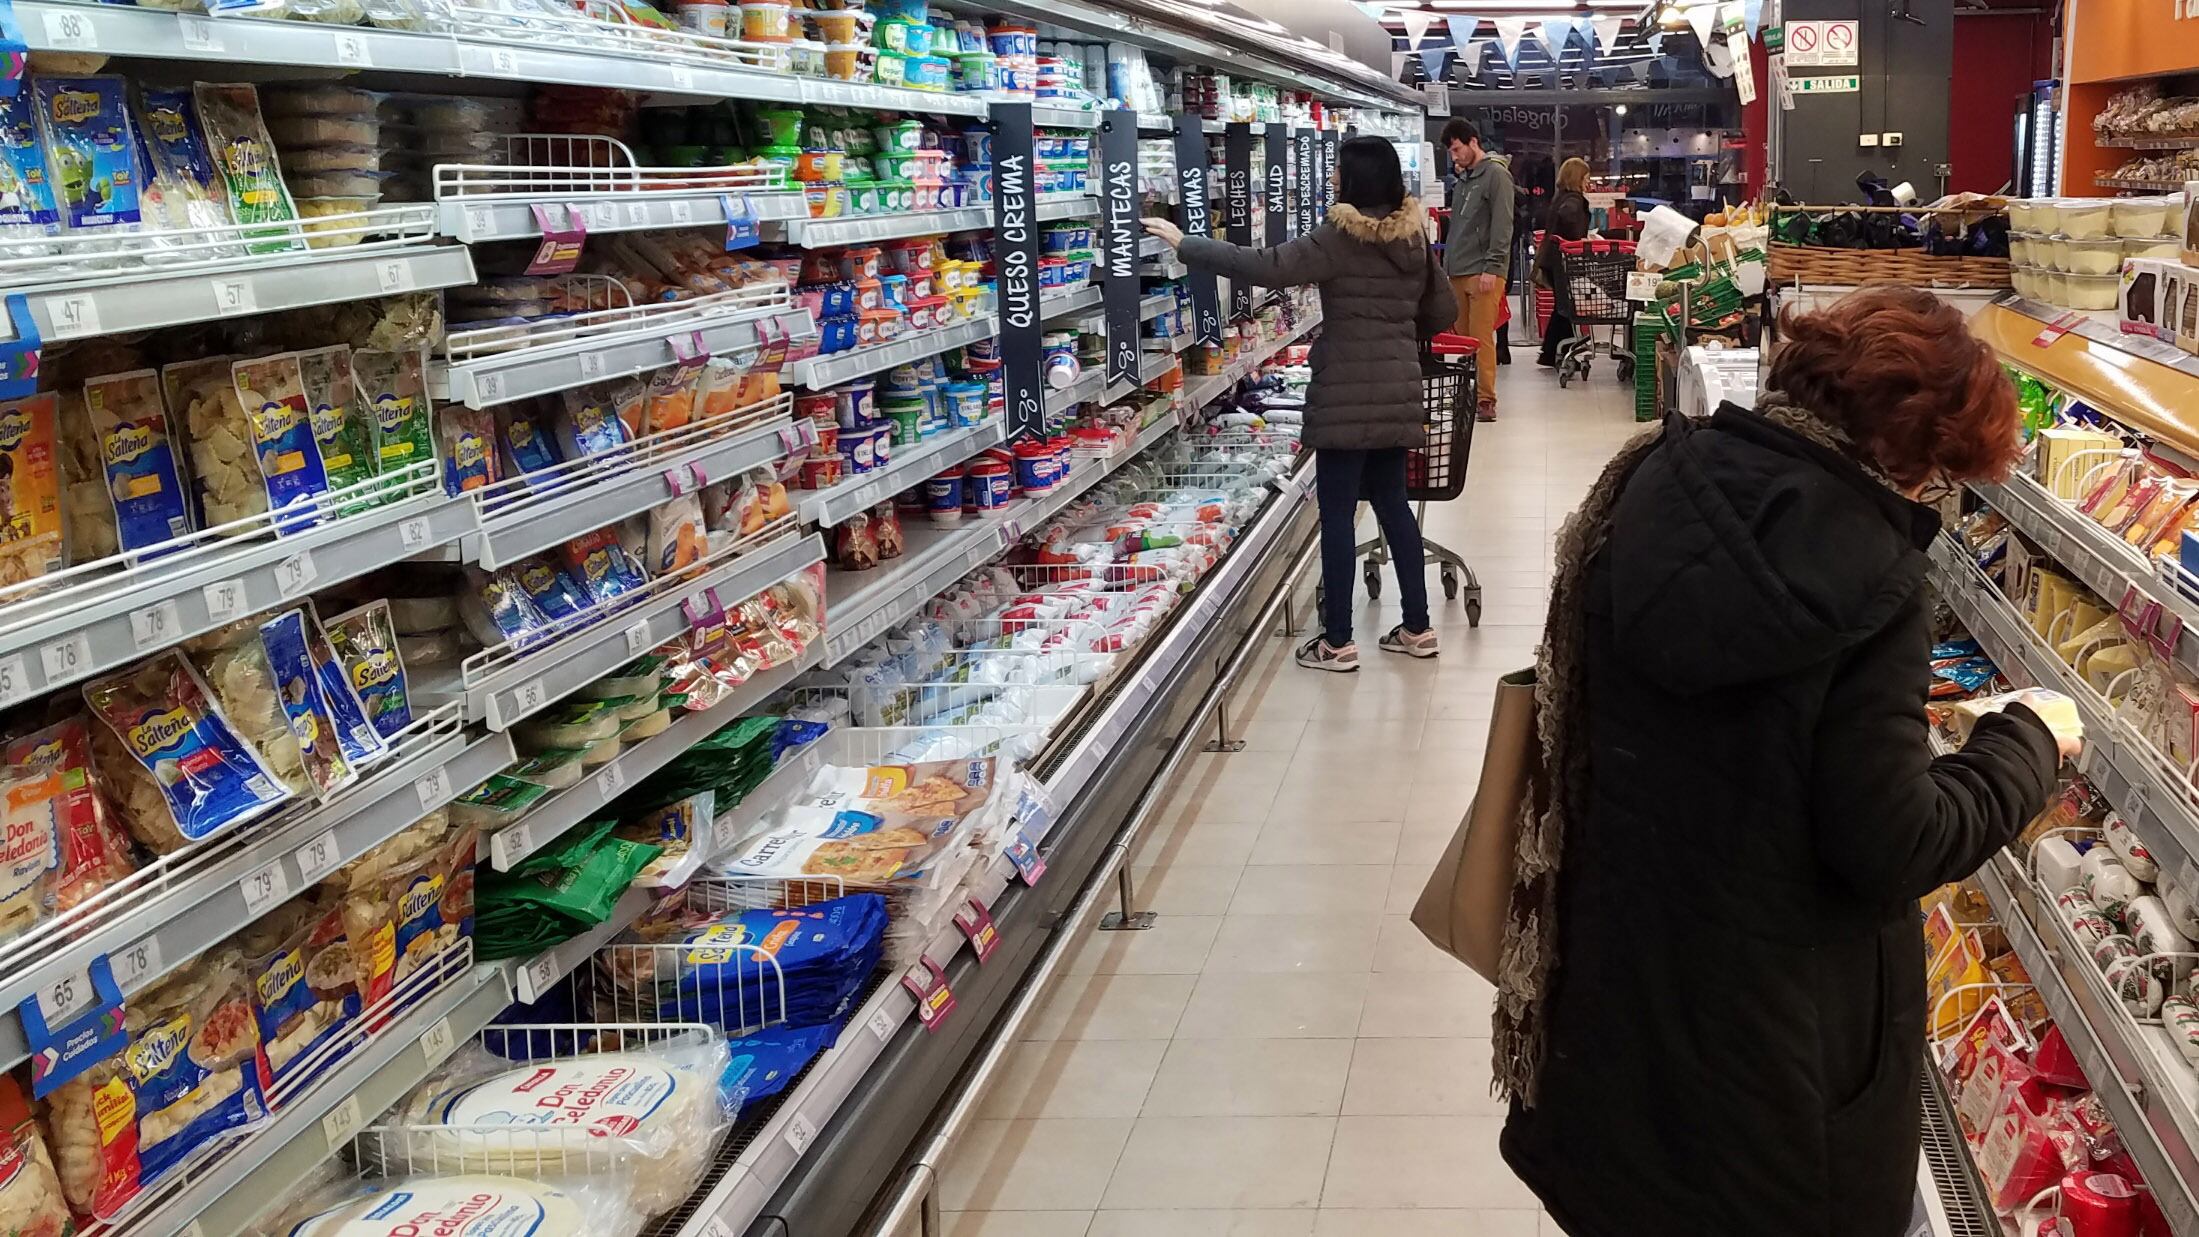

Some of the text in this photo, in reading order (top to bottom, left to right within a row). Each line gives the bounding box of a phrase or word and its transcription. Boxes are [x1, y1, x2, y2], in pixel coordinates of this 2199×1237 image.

[1809, 79, 1851, 90] SALIDA
[1300, 135, 1311, 207] DESCREMADO
[1229, 170, 1247, 228] LECHES
[1269, 164, 1284, 213] SALUD
[1182, 167, 1207, 239] REMAS
[1109, 161, 1133, 278] MANTECAS
[999, 154, 1034, 328] QUESO CREMA
[1647, 277, 1658, 287] 19
[227, 284, 242, 305] 57
[64, 299, 82, 323] 47
[108, 434, 148, 461] Salteña
[286, 560, 302, 579] 79
[221, 588, 235, 608] 79
[148, 612, 164, 636] 78
[136, 714, 190, 753] Salteña
[427, 775, 441, 794] 79
[7, 820, 34, 843] Don
[310, 843, 326, 865] 79
[254, 871, 271, 897] 79
[127, 947, 147, 975] 78
[54, 978, 74, 1008] 65
[62, 1036, 98, 1061] Cuidados
[66, 1028, 94, 1050] Precios
[535, 1083, 584, 1107] Don
